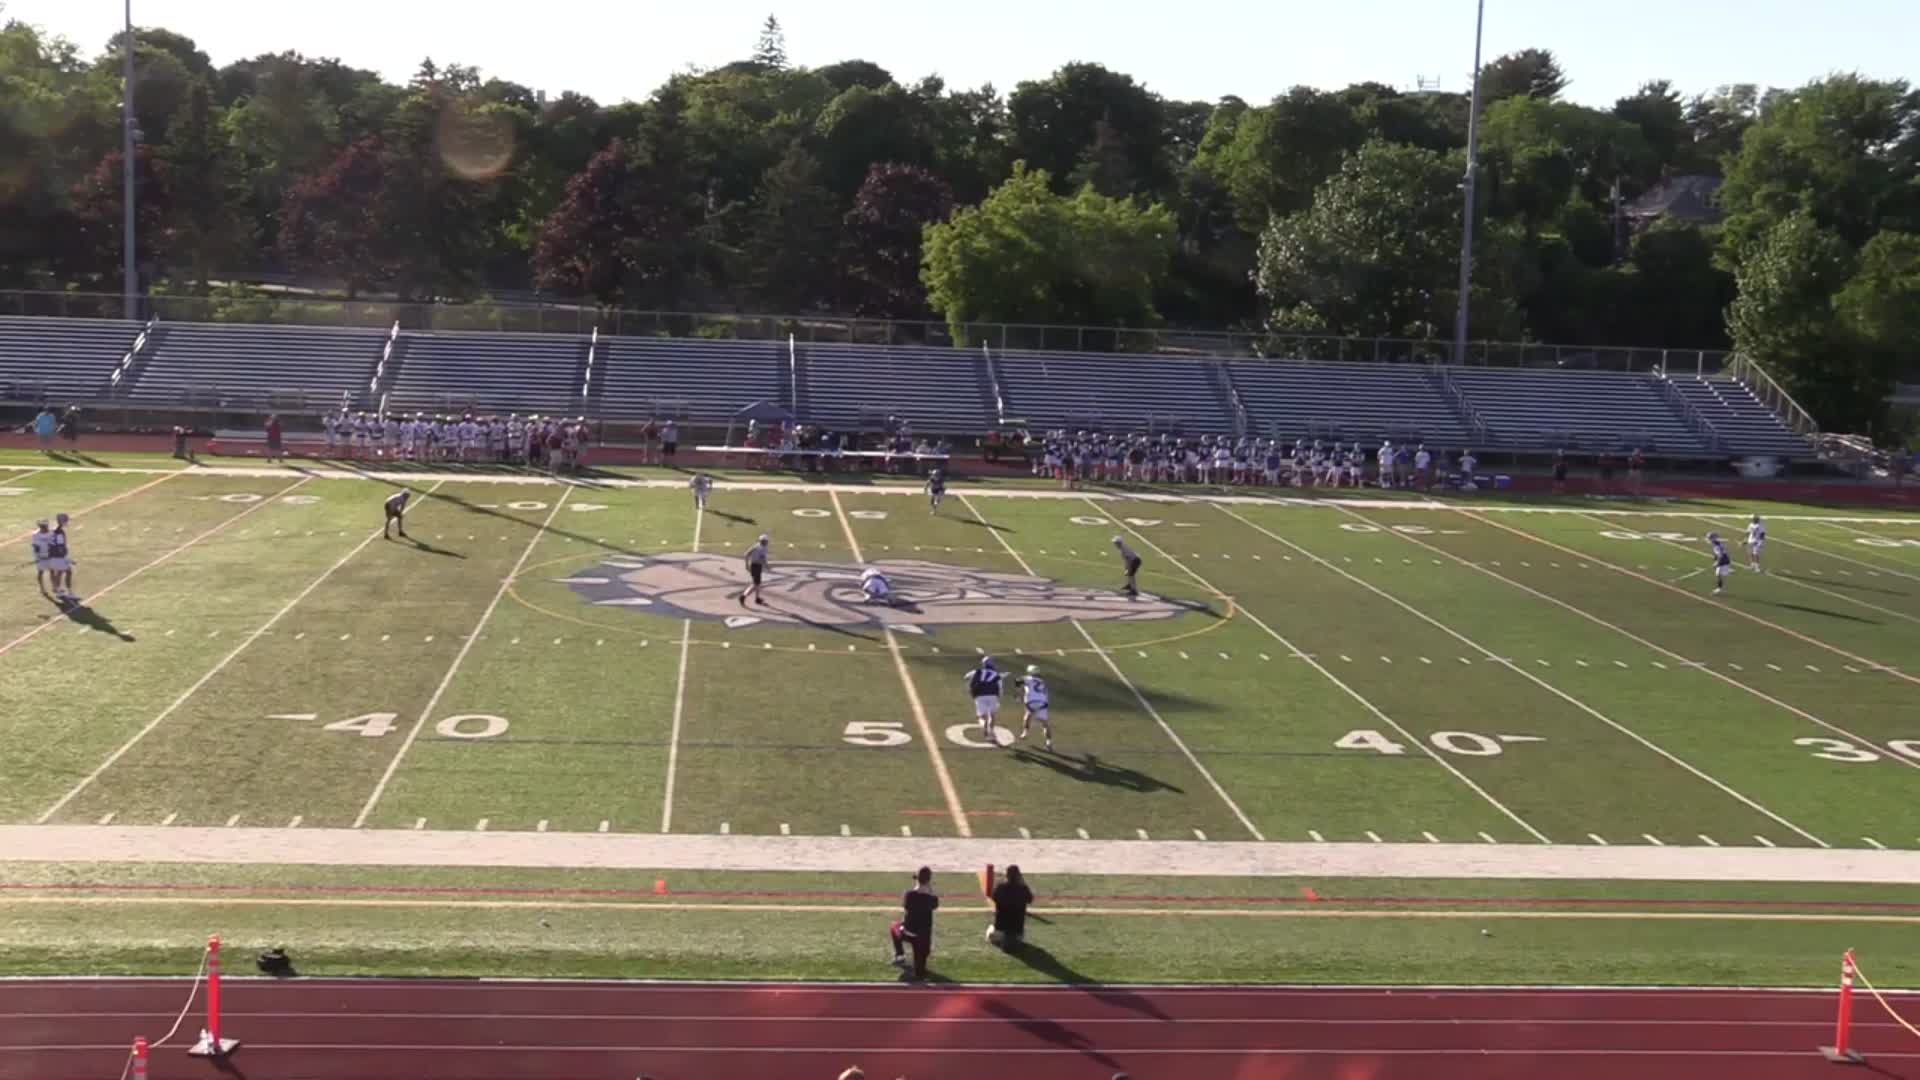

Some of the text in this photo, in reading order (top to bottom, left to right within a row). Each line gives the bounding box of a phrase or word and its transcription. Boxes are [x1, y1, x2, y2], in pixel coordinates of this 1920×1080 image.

[980, 669, 998, 682] 17
[322, 712, 509, 738] 40
[842, 721, 1015, 747] 50
[1333, 730, 1503, 756] 40
